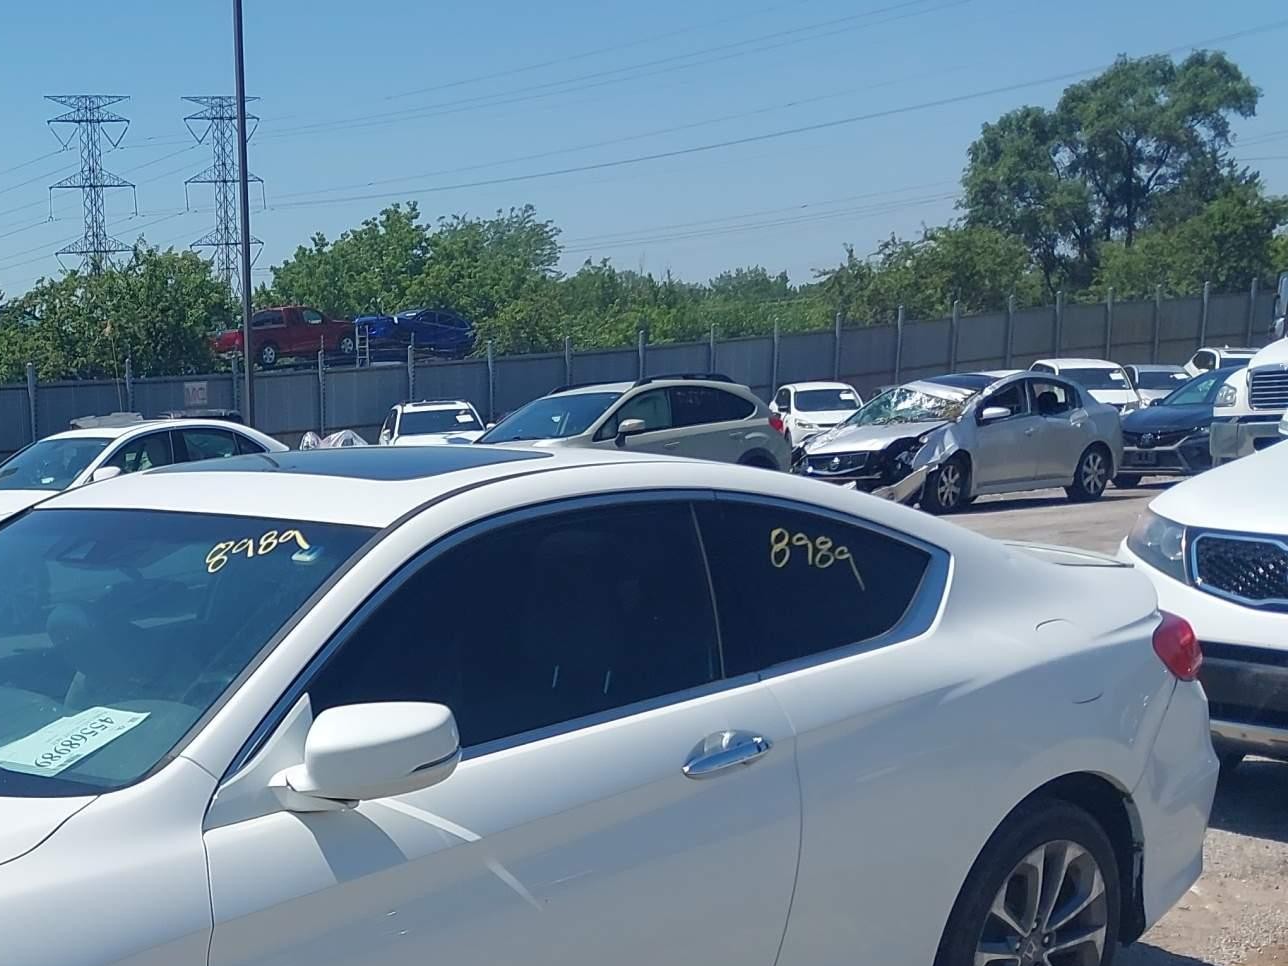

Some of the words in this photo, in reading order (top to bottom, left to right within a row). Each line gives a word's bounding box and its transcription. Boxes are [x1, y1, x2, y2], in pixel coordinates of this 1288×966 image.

[206, 529, 310, 573] 8989
[770, 527, 865, 591] 8989
[34, 716, 114, 768] 45568989
